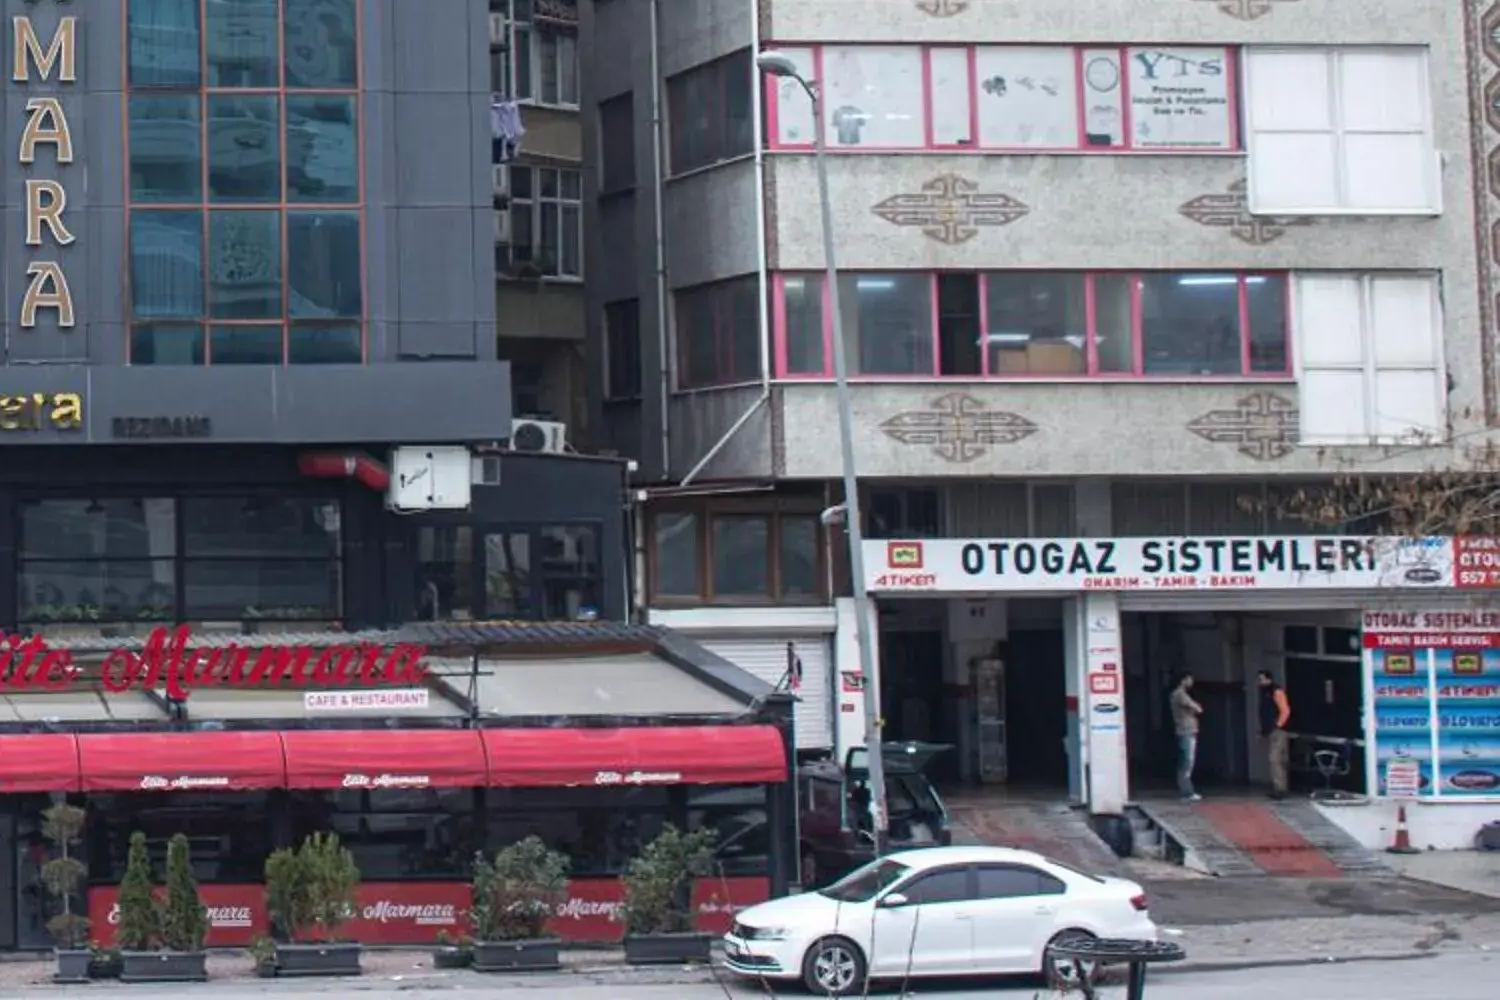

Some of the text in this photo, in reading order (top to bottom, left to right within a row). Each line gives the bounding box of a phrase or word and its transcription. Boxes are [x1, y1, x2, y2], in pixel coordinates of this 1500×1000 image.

[1134, 50, 1222, 79] YTS
[961, 542, 1116, 575] OTOGAZ
[1211, 575, 1256, 587] BAKIM
[1364, 613, 1416, 628] OTOGAZ
[102, 624, 429, 700] Marmara
[308, 695, 336, 706] CAFE
[352, 693, 426, 705] RESTAURANT
